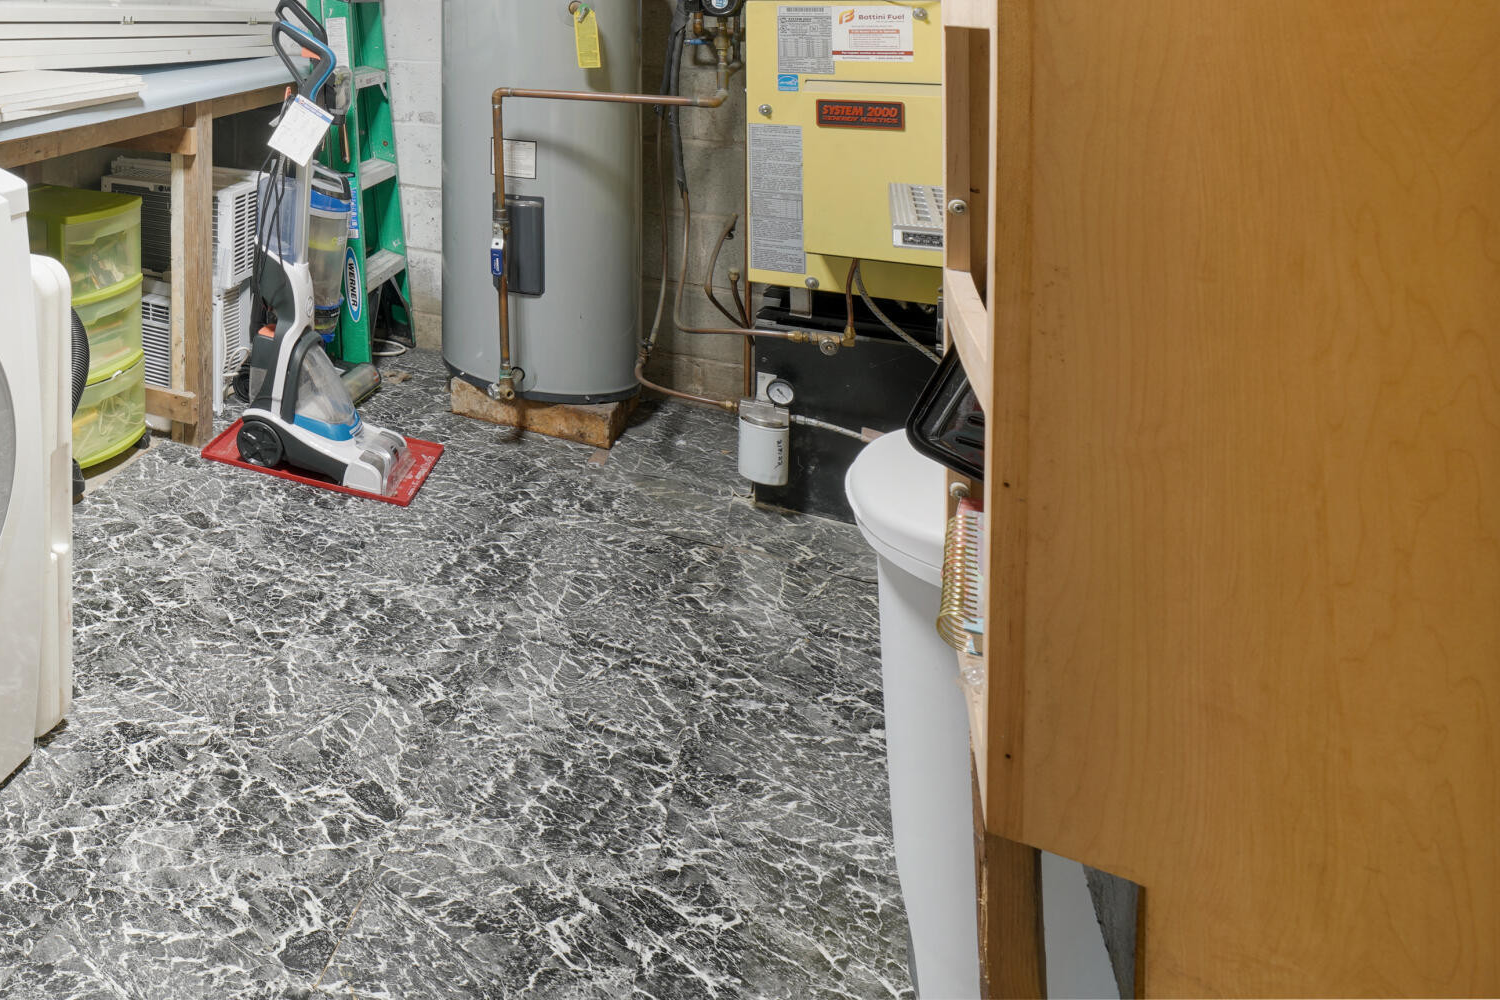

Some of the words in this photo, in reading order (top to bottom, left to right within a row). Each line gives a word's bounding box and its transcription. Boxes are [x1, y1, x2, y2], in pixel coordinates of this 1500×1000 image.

[858, 13, 886, 21] Bottini
[887, 13, 905, 21] Fuel
[822, 104, 864, 117] SYSTEM
[866, 106, 898, 118] 2000
[347, 262, 358, 308] WERNER
